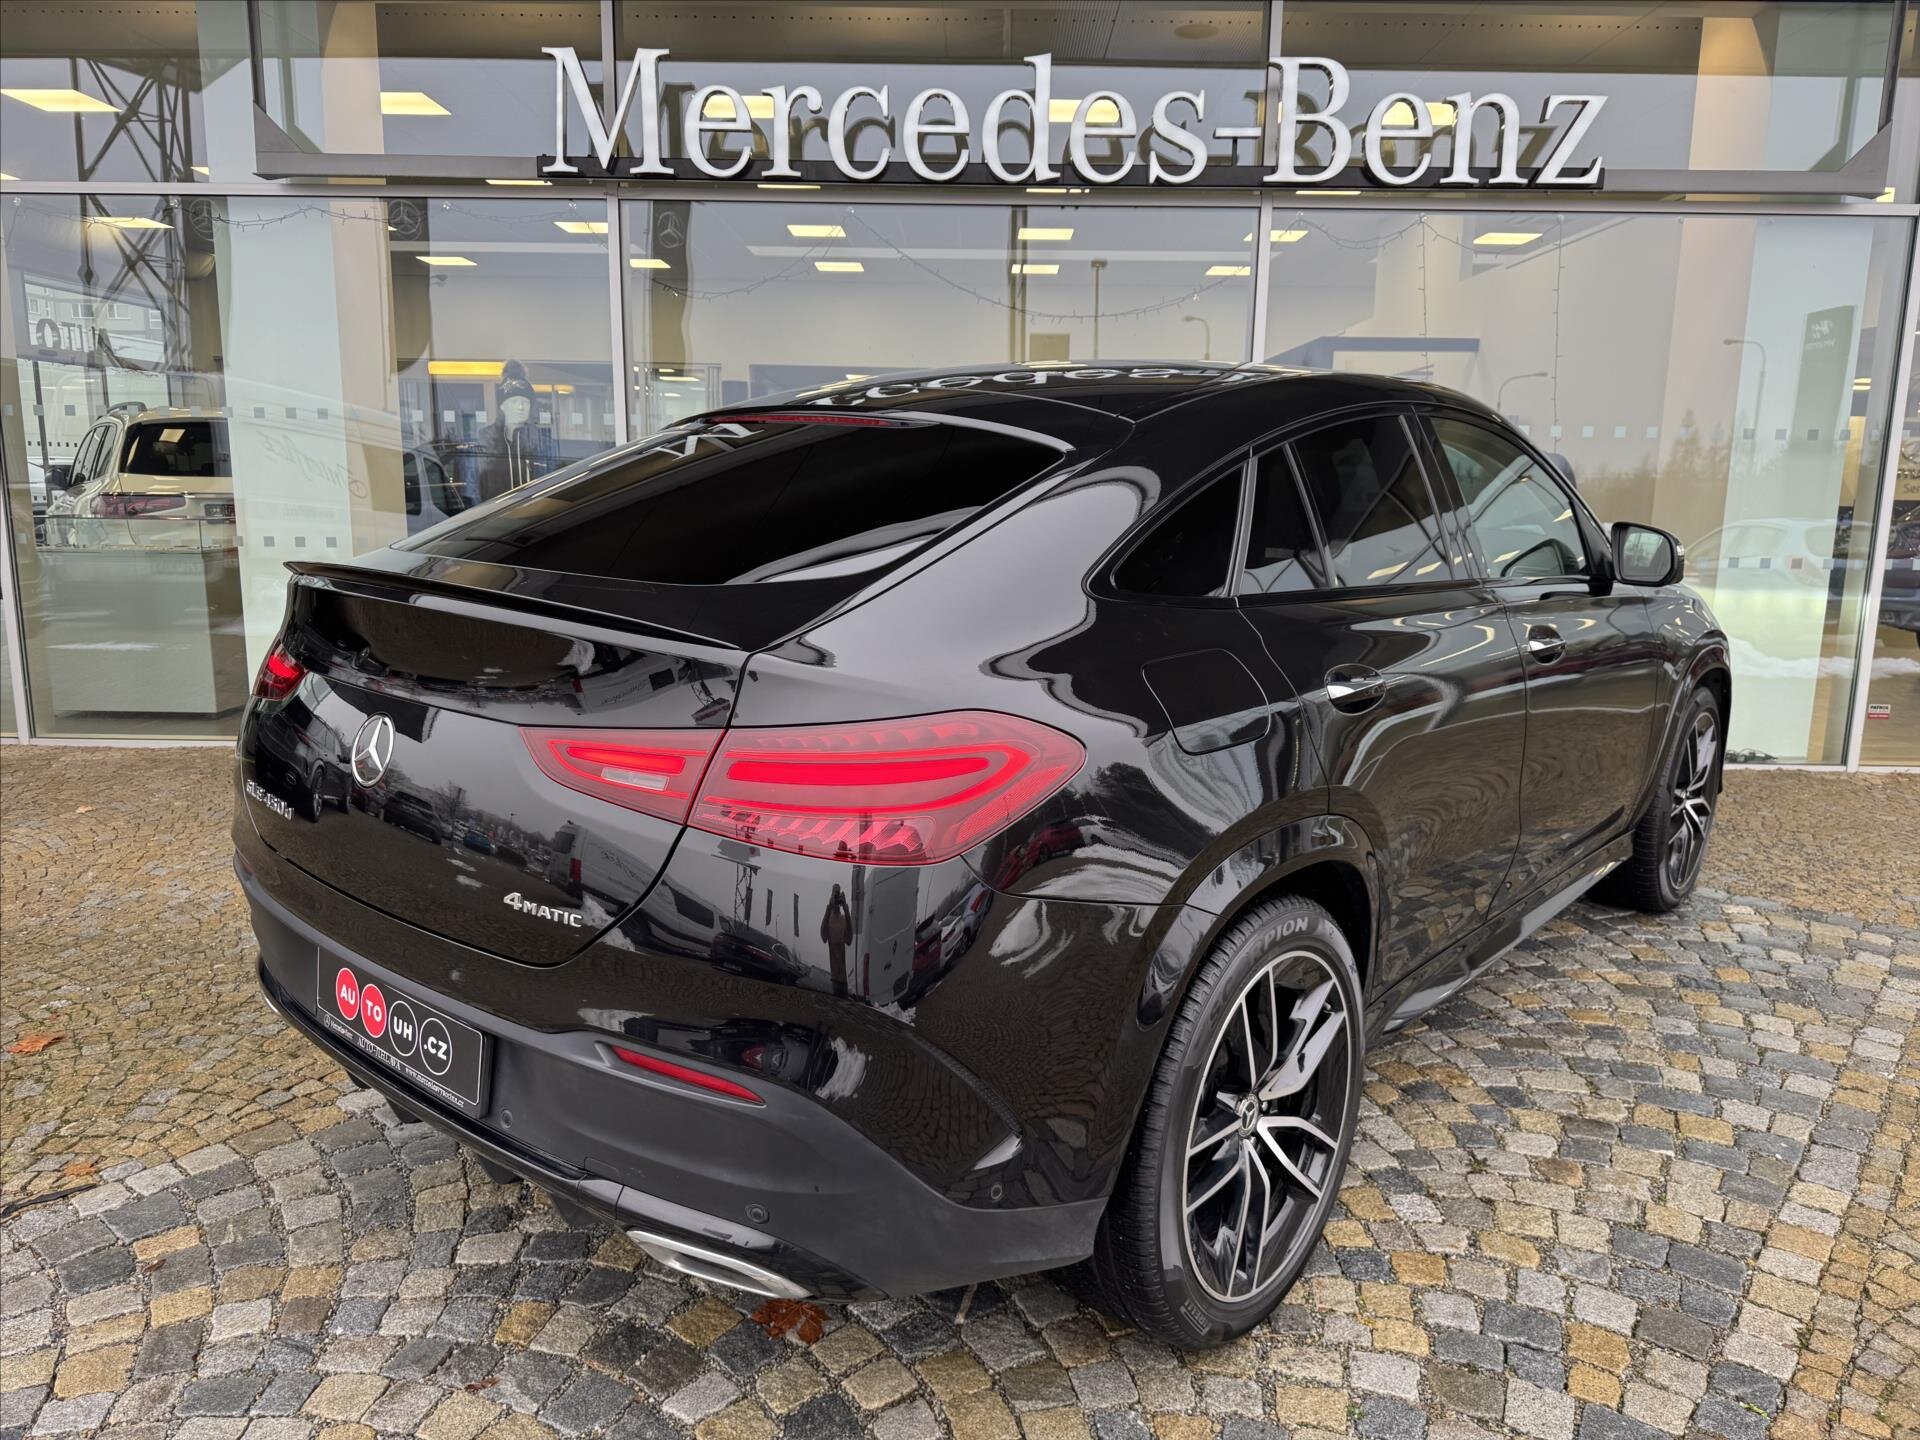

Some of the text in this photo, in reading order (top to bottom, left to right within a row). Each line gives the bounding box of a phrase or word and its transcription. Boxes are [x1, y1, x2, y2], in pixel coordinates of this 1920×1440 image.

[541, 46, 1608, 187] Mercedes-Benz
[503, 891, 582, 928] 4MATIC
[340, 985, 356, 1005] AU
[365, 999, 383, 1022] TO
[393, 1016, 413, 1042] UH
